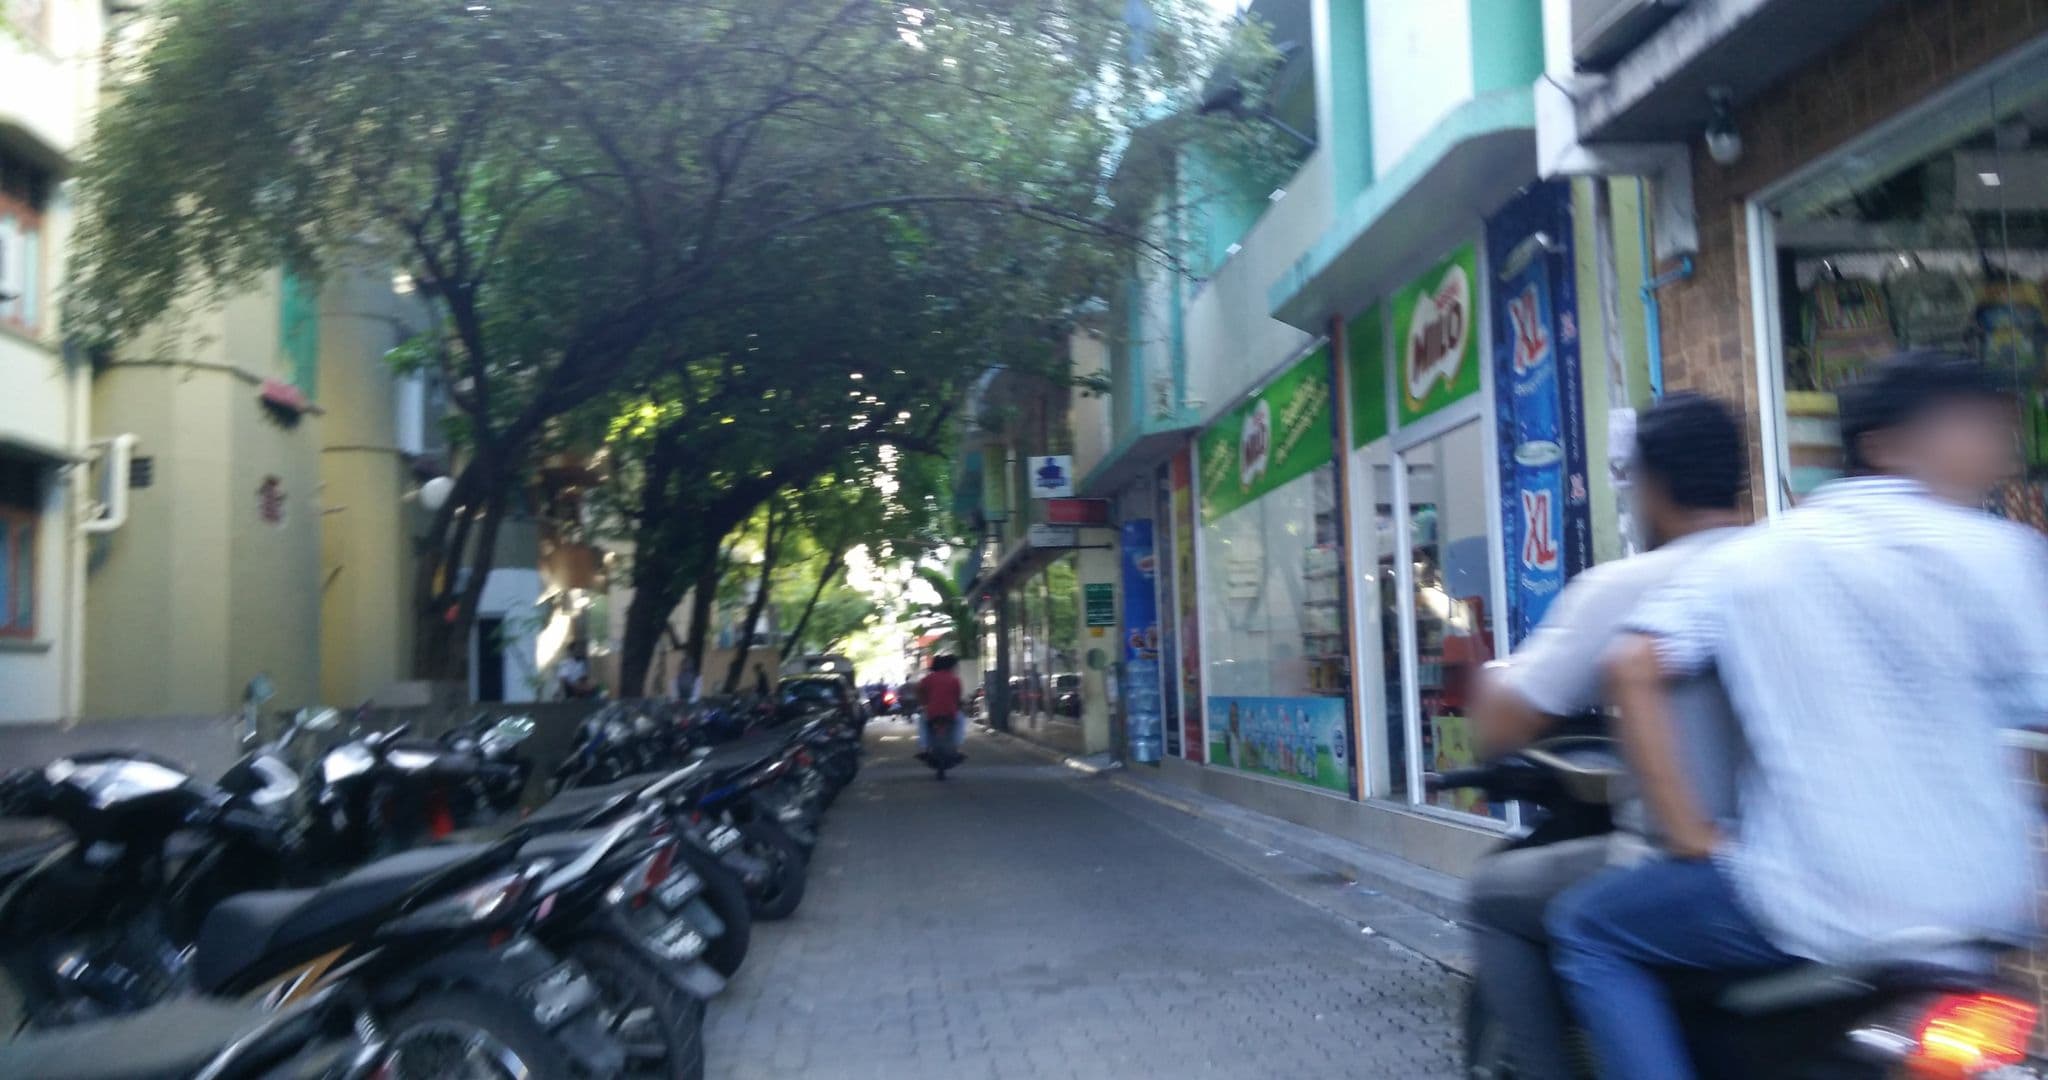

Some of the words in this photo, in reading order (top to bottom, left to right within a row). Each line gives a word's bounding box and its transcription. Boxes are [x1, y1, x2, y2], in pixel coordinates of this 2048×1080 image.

[1412, 300, 1462, 384] MILO
[1510, 286, 1547, 372] XL
[1522, 490, 1557, 568] XL
